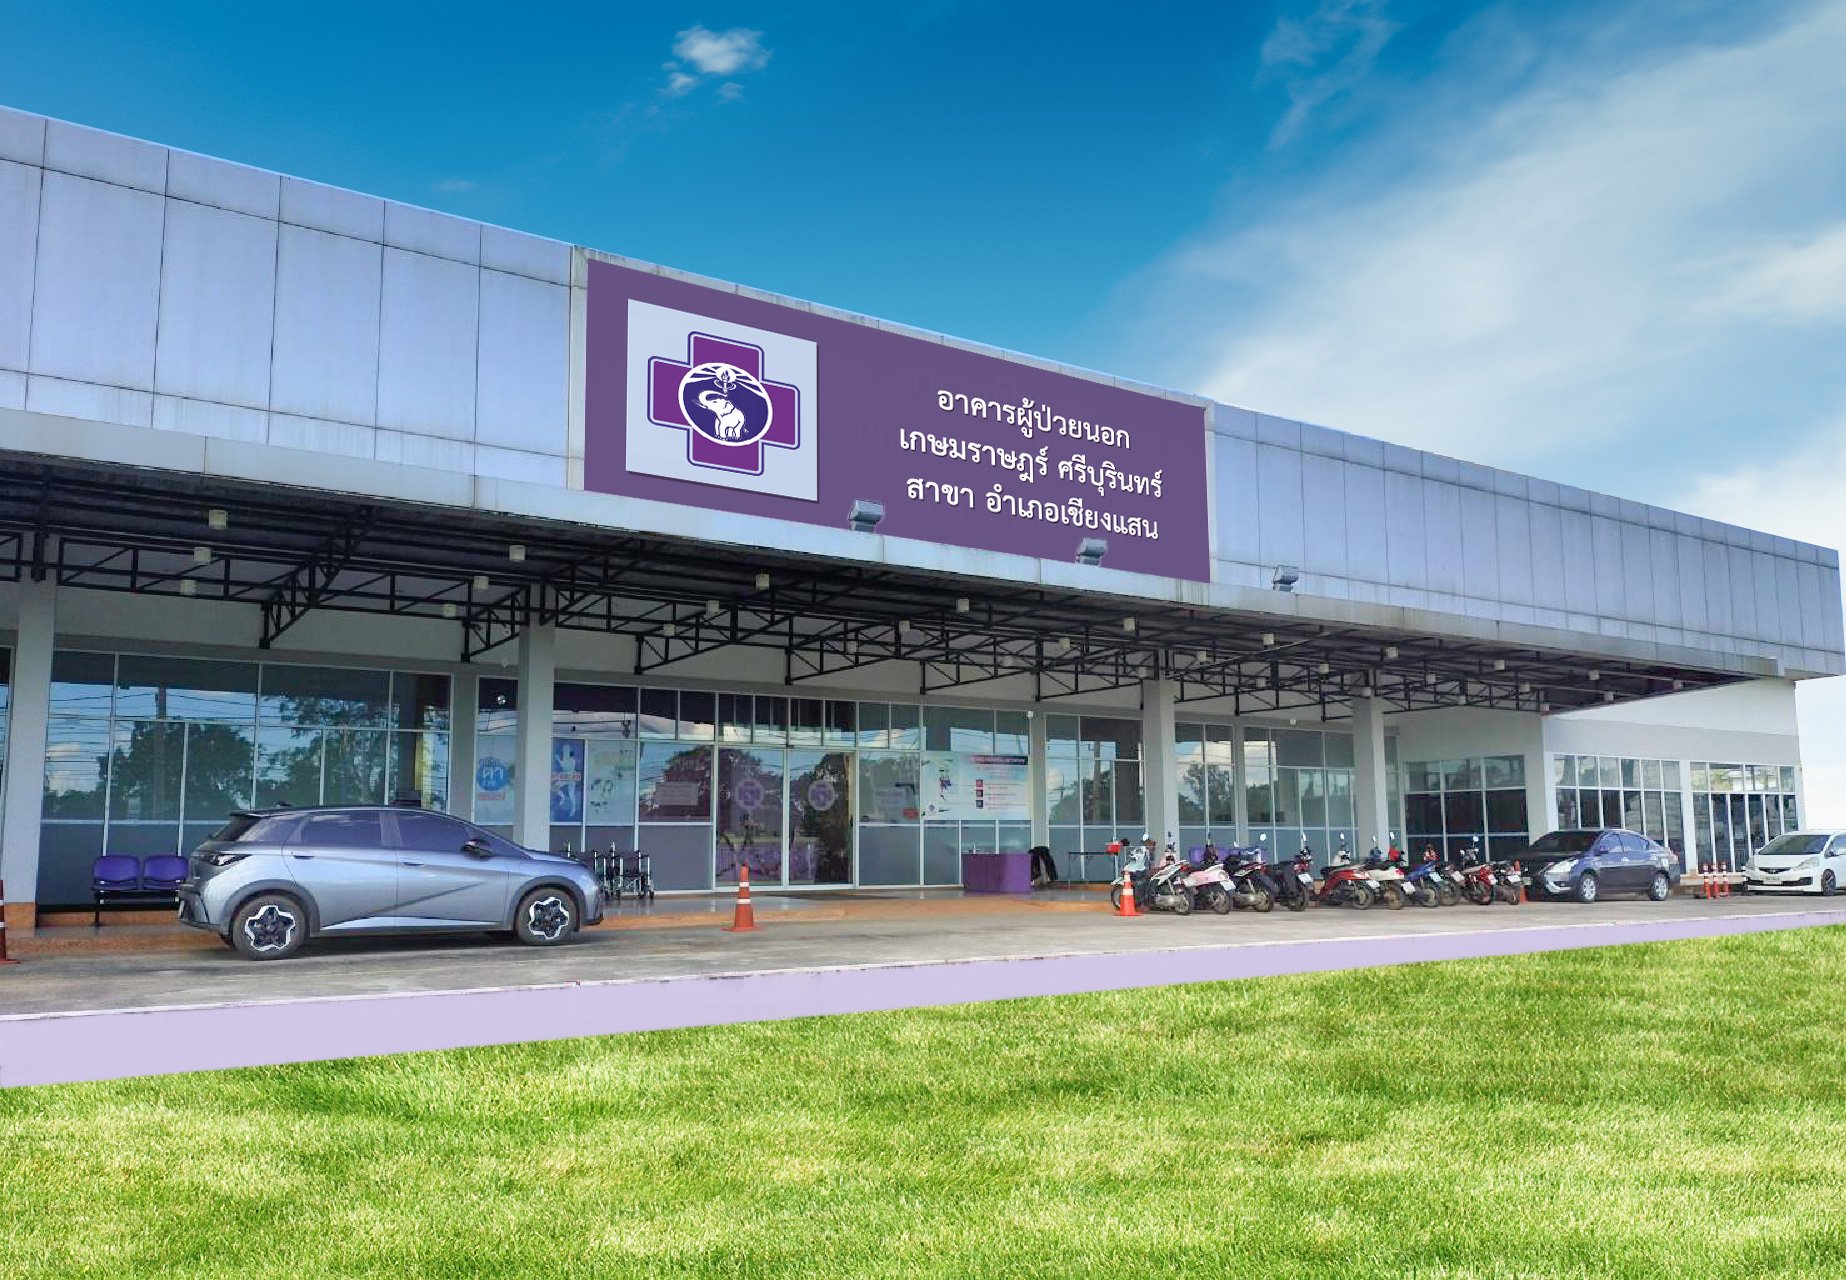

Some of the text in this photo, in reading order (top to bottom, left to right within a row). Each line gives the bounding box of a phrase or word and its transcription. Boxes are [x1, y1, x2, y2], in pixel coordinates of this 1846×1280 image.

[937, 389, 1131, 450] อาคารผู้ป่วยนอก
[900, 428, 1163, 499] เกษมราษฎร์ ศรีบุรินทร์
[907, 478, 1159, 540] สาขา อำเภอเชียงแสน
